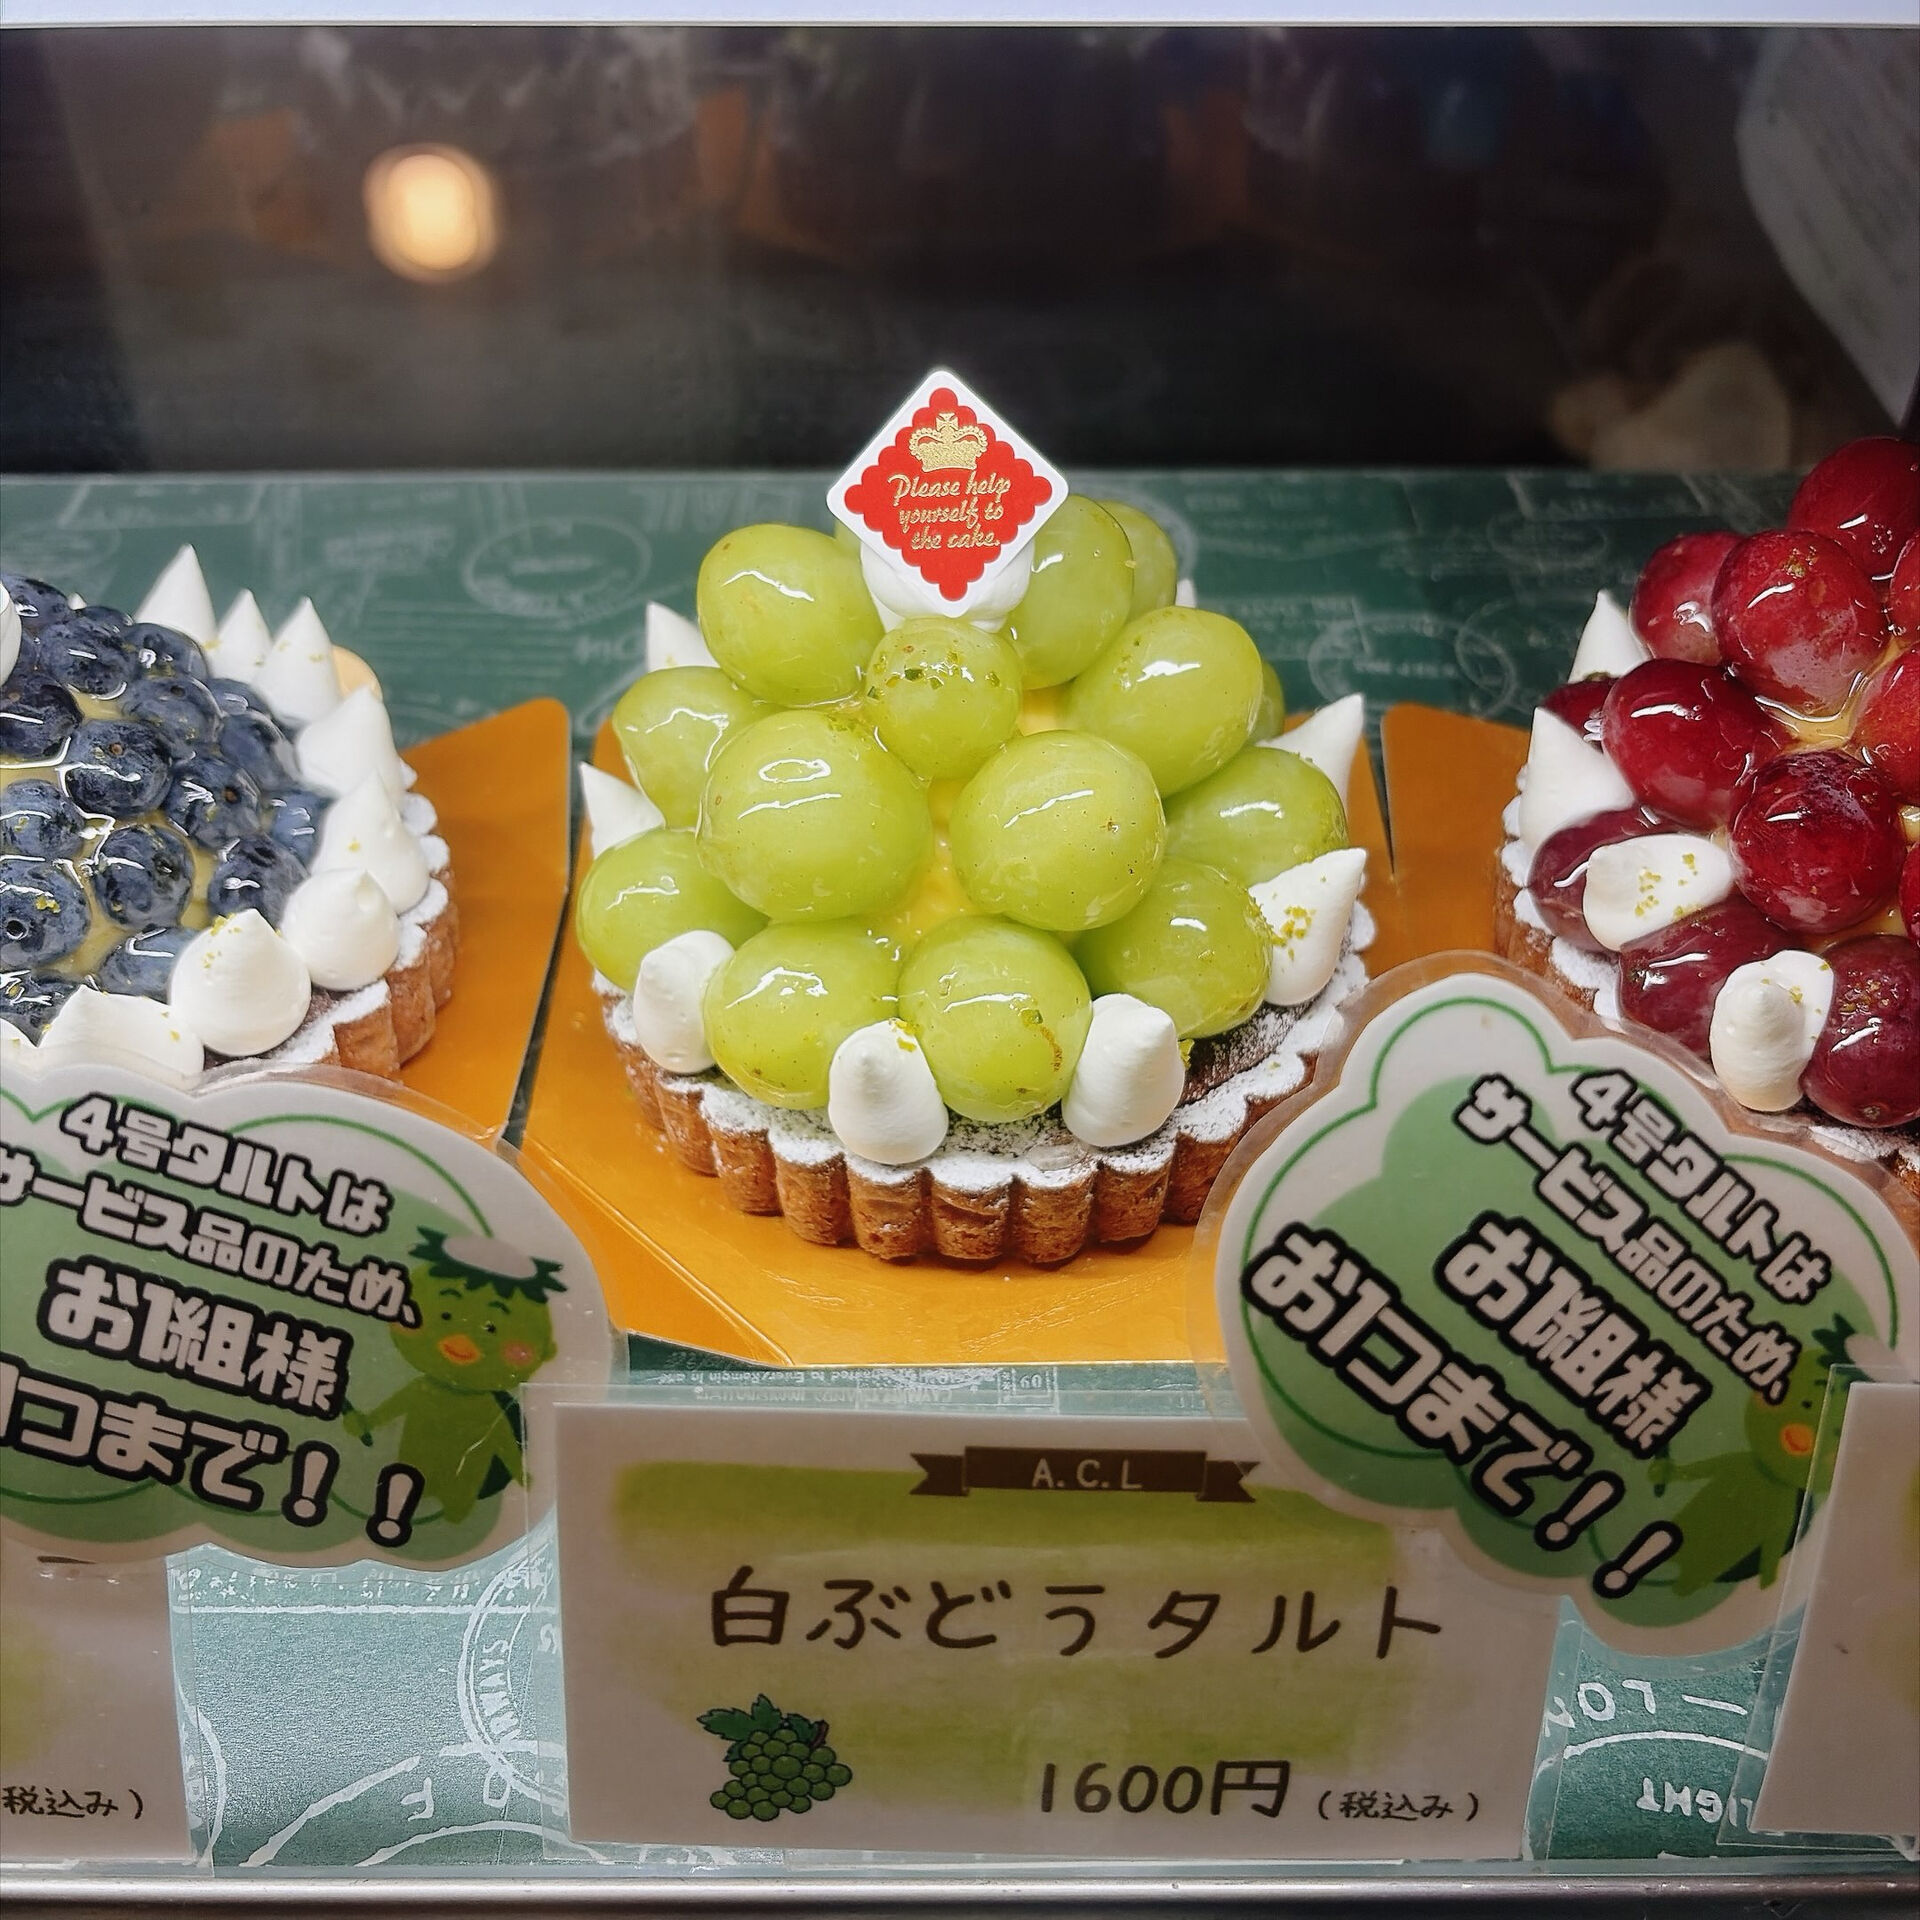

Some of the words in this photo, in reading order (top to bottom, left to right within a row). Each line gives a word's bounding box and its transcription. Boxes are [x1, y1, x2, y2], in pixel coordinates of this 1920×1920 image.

[887, 474, 960, 507] Please
[965, 471, 1010, 503] help
[899, 496, 978, 533] yourself
[983, 505, 1004, 521] to
[912, 526, 942, 550] the
[0, 1143, 423, 1328] サービス品のため、
[60, 1093, 395, 1236] 4号タルトは
[1571, 1068, 1831, 1304] 4号タルトは
[1452, 1073, 1802, 1404] サービス品のため、
[40, 1255, 354, 1421] お1組様
[1433, 1210, 1713, 1461] お1組様
[712, 1565, 1442, 1659] 白ぶどうタルト
[1040, 1759, 1291, 1818] 1600円
[1317, 1788, 1480, 1822] (税込み)
